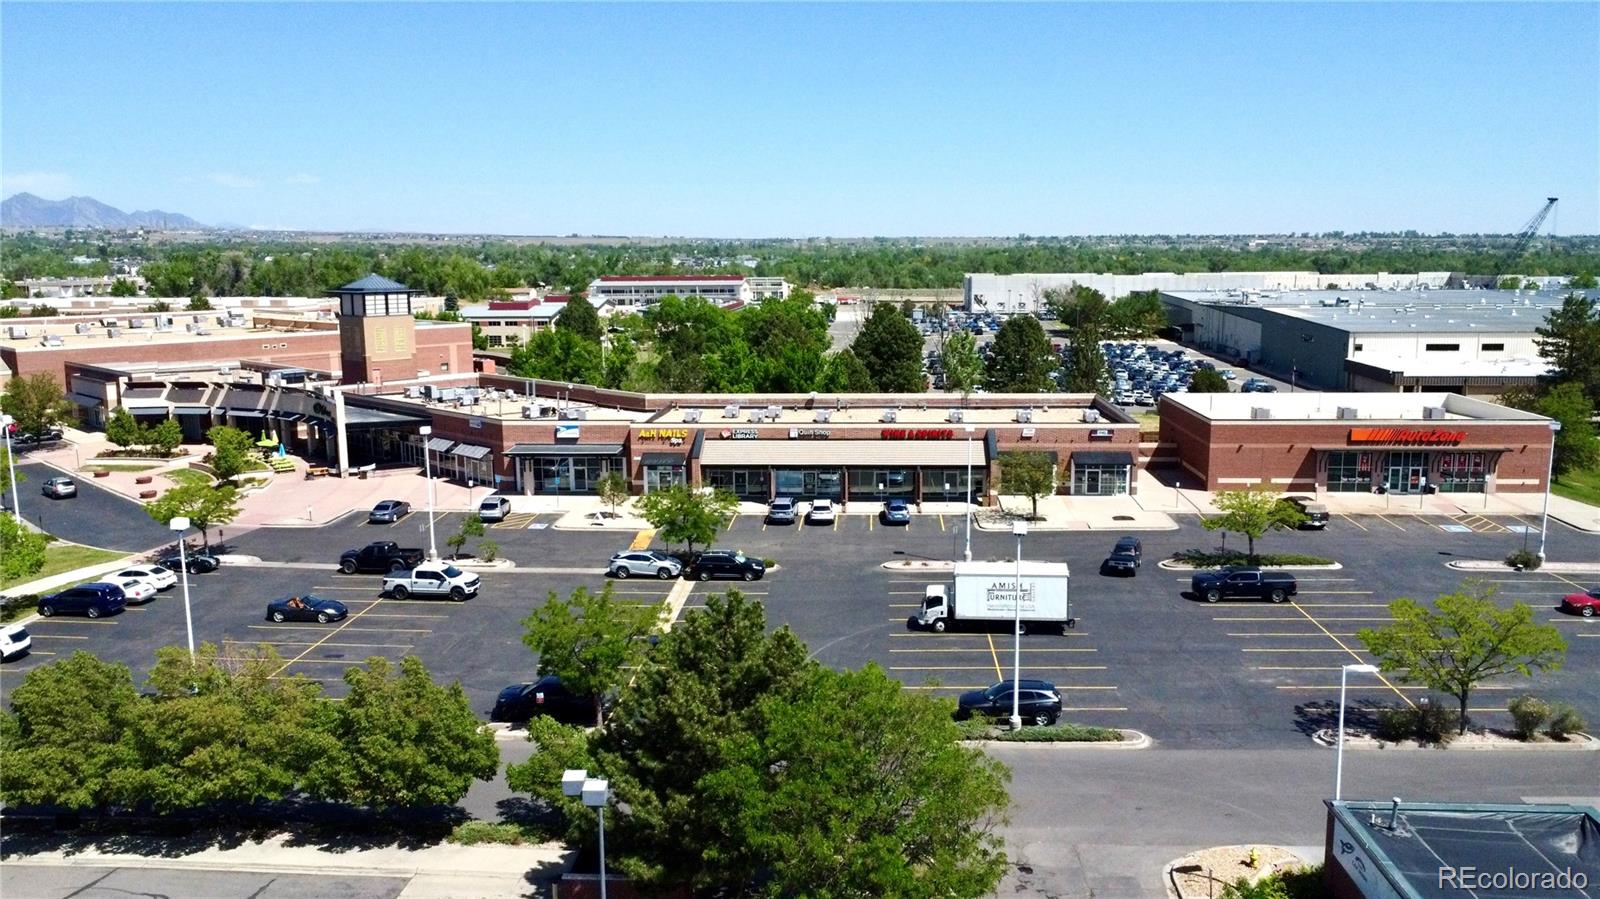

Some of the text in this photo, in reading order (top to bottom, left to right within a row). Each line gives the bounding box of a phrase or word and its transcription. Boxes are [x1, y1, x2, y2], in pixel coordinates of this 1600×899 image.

[659, 428, 688, 438] NAILS
[815, 429, 831, 437] Shop
[1400, 428, 1466, 441] AutoZone
